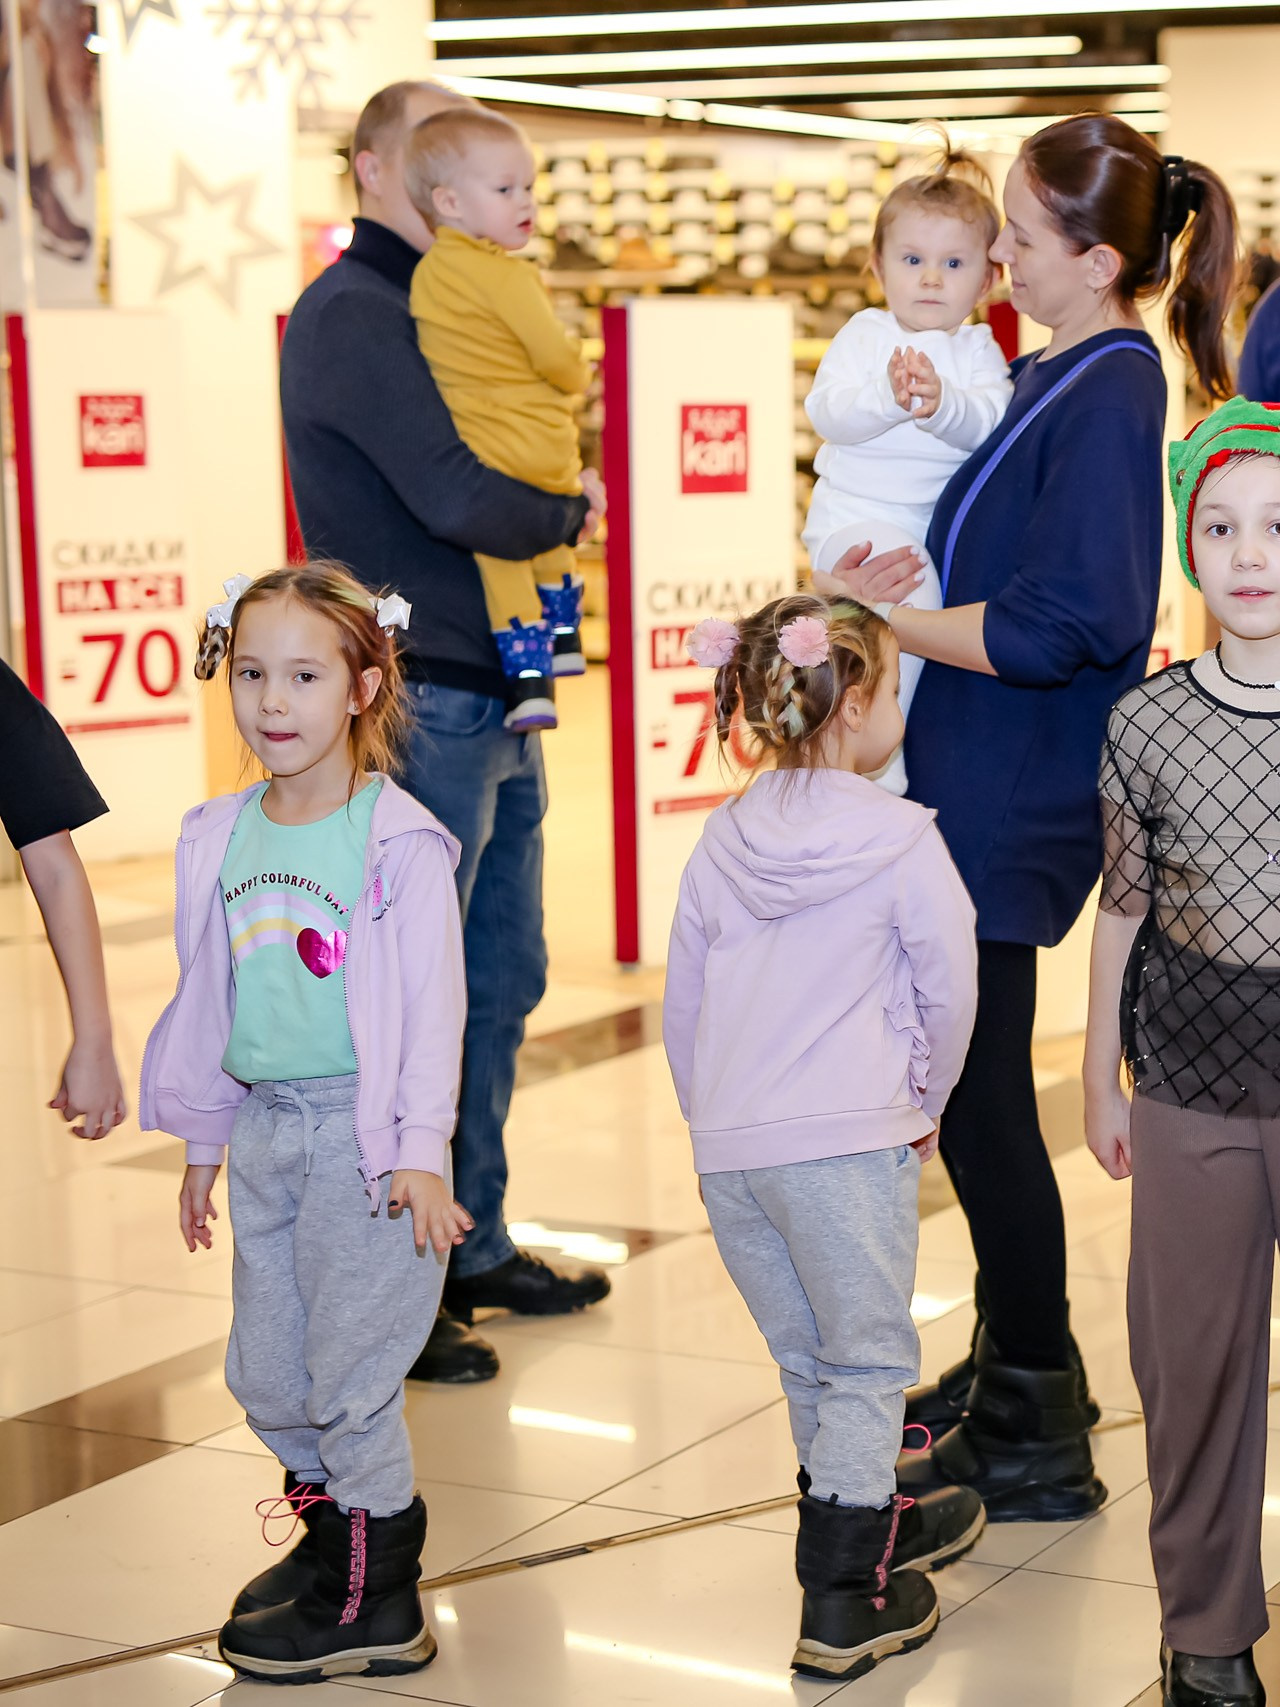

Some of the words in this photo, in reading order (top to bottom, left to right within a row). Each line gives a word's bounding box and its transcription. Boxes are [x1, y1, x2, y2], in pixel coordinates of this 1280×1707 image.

[683, 430, 746, 476] kari
[53, 540, 184, 571] СКИДКИ
[62, 629, 181, 703] -70
[225, 876, 258, 903] HAPPY
[261, 873, 321, 896] COLORFUL
